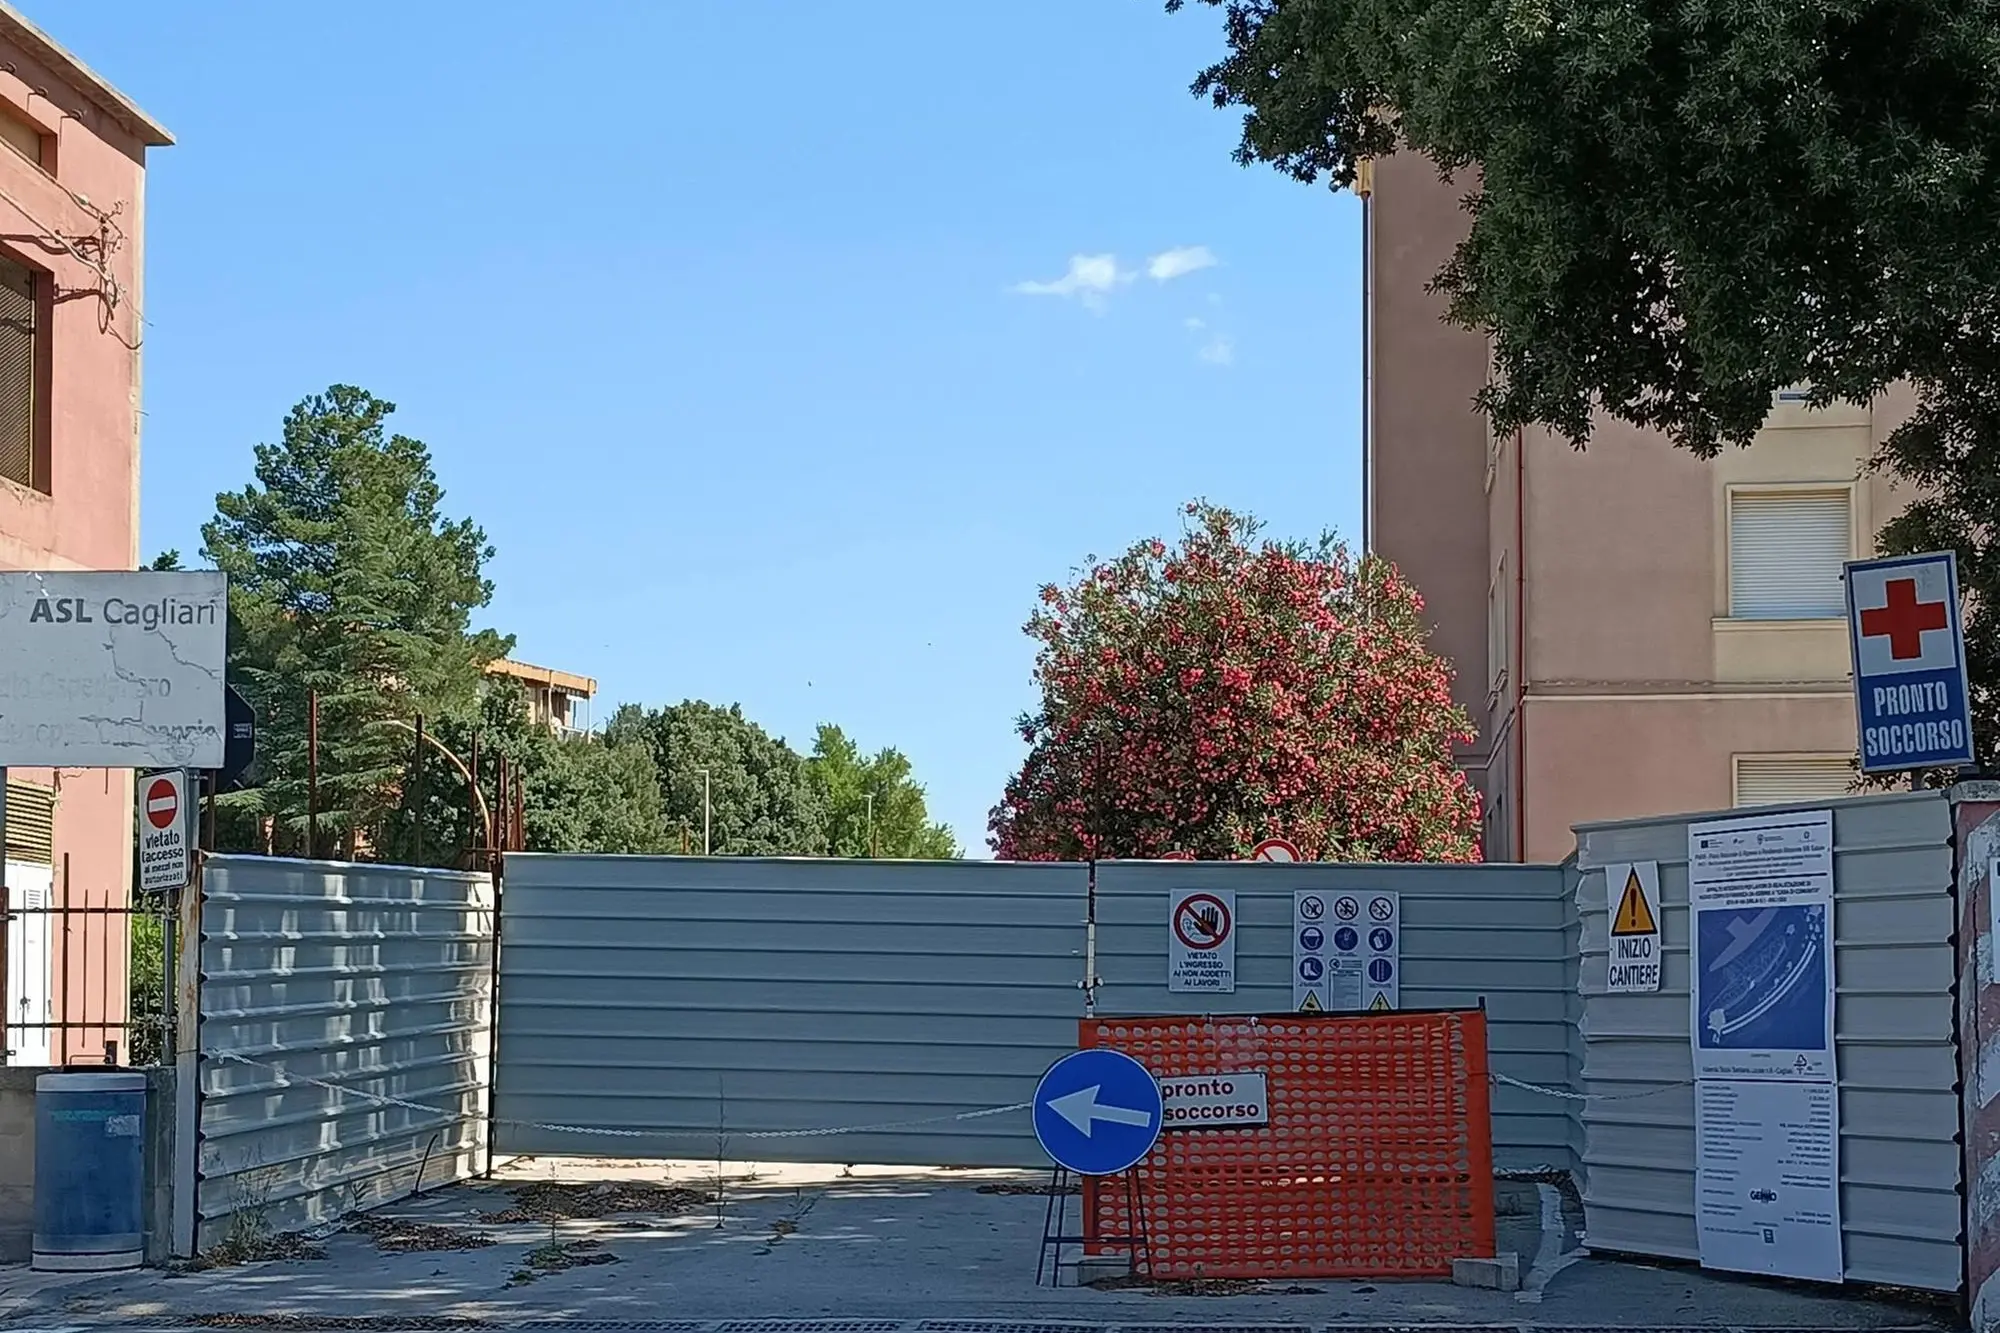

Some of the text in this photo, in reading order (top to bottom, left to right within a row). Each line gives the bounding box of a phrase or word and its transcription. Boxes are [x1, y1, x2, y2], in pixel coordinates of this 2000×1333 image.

[30, 598, 216, 631] ASL Cagliari
[1873, 681, 1948, 716] PRONTO
[1865, 719, 1964, 756] SOCCORSO
[146, 829, 180, 849] vietato
[172, 861, 184, 869] non
[1187, 951, 1217, 959] VIETATO
[1617, 938, 1651, 959] INIZIO
[1179, 961, 1223, 969] L'INGRESSO
[1200, 970, 1232, 978] ADDETTI
[1609, 964, 1658, 986] CANTIERE
[1193, 979, 1220, 987] LAVORI
[1162, 1078, 1234, 1099] pronto
[1164, 1103, 1259, 1121] soccorso
